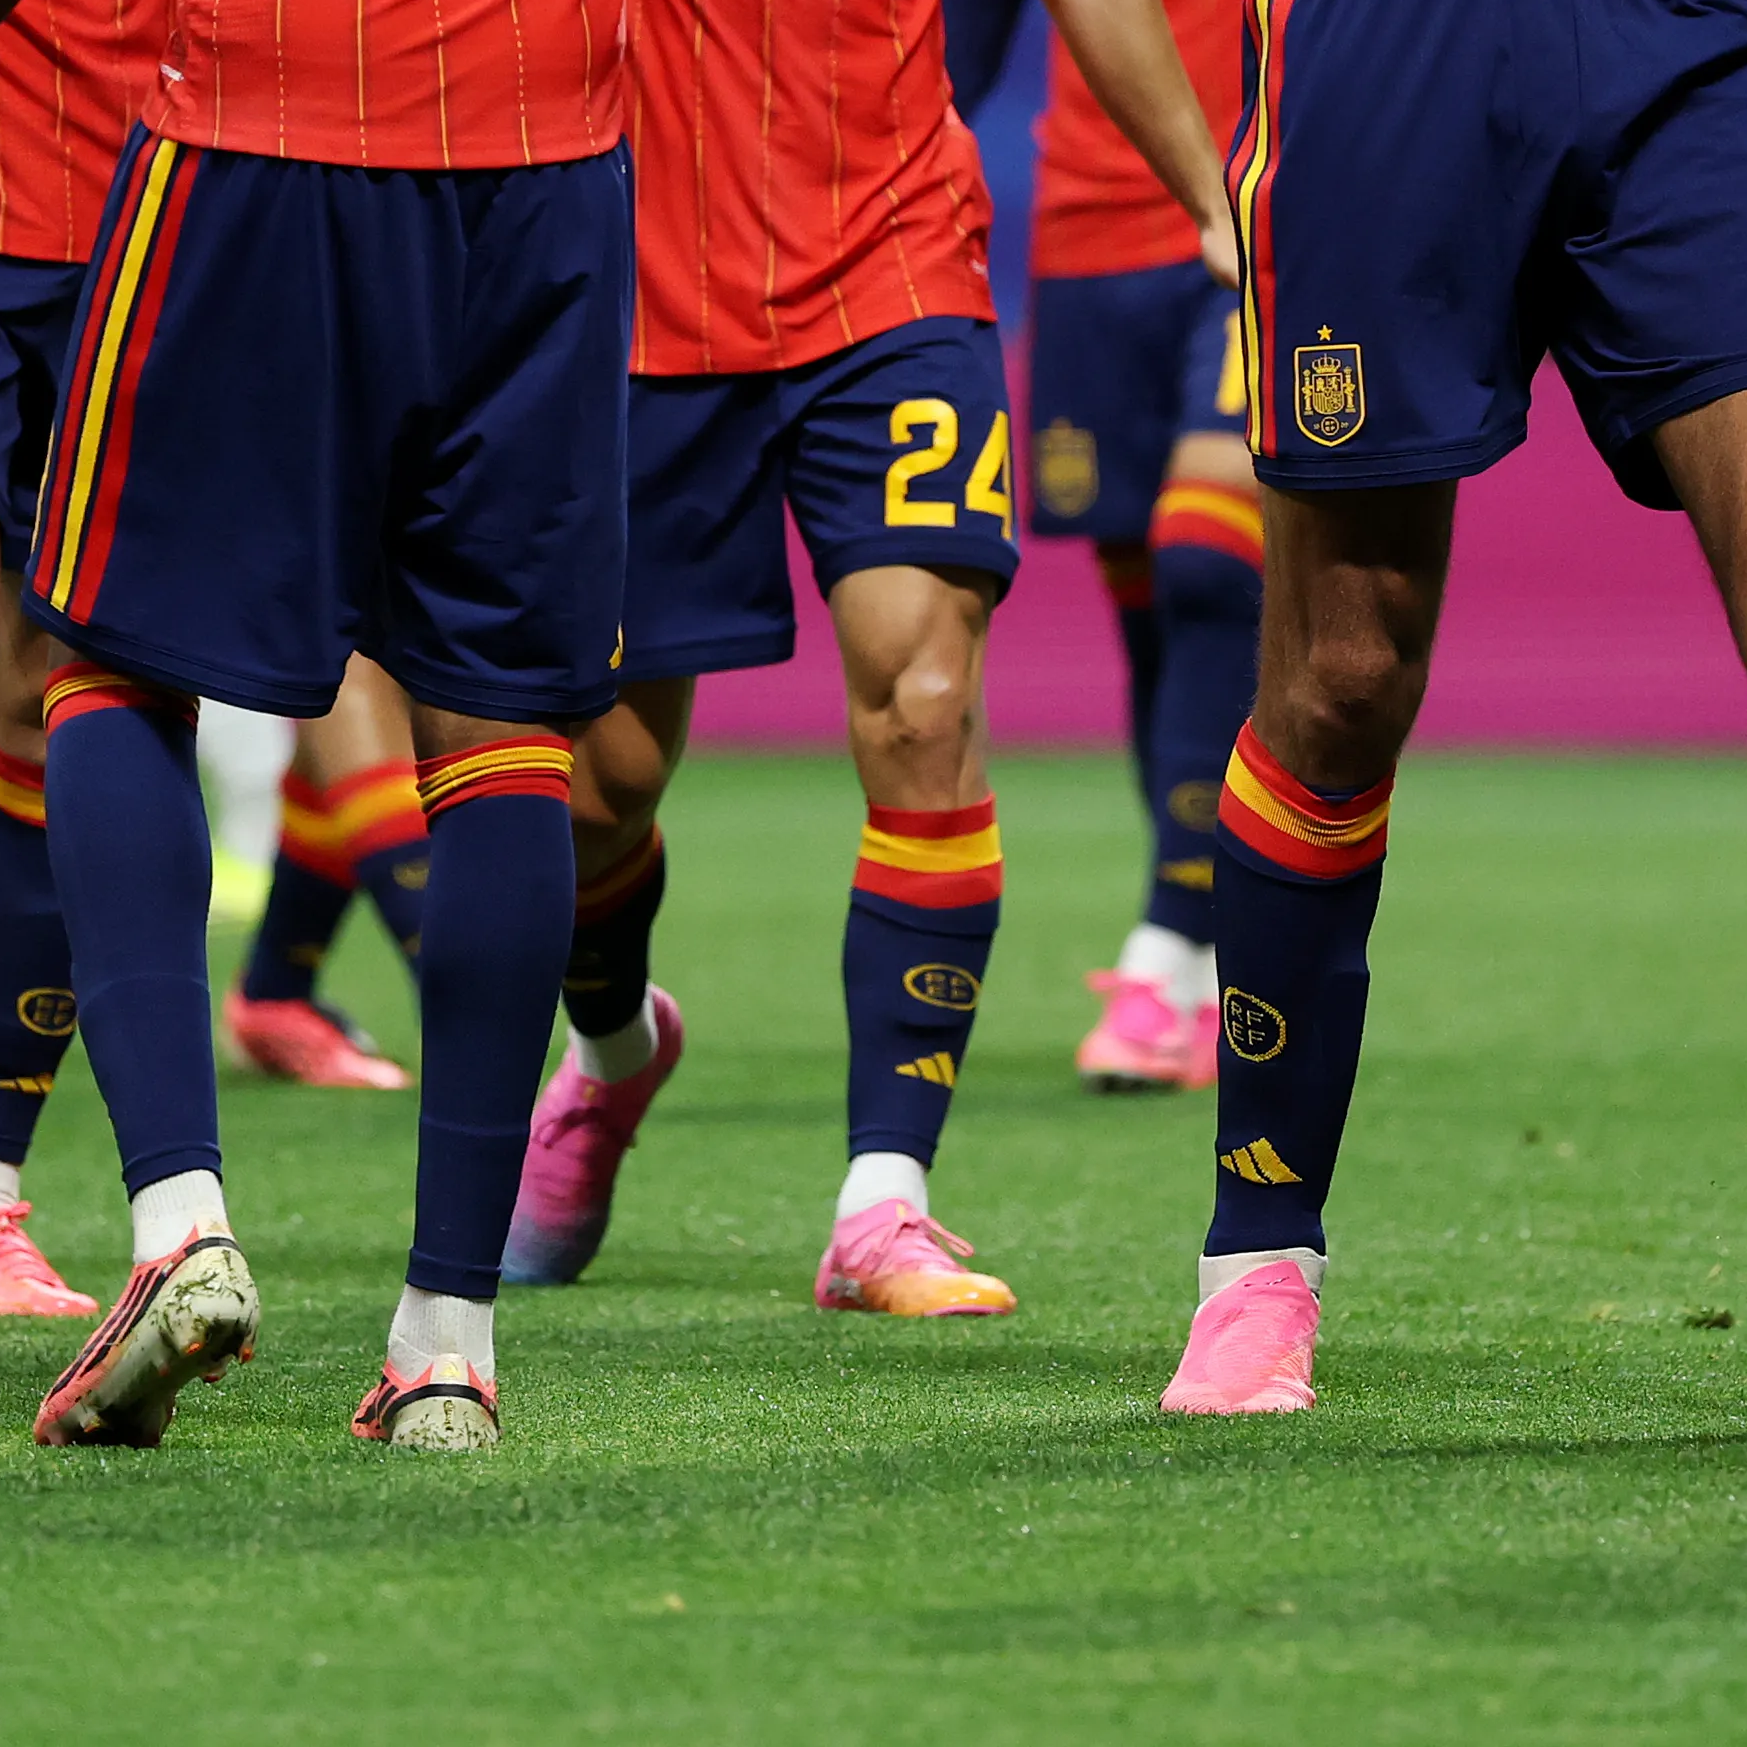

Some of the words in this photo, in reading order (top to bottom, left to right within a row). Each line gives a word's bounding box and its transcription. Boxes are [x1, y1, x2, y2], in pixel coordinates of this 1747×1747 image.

[884, 397, 1013, 540] 24
[1230, 999, 1264, 1026] RF
[1232, 1020, 1266, 1047] EF
